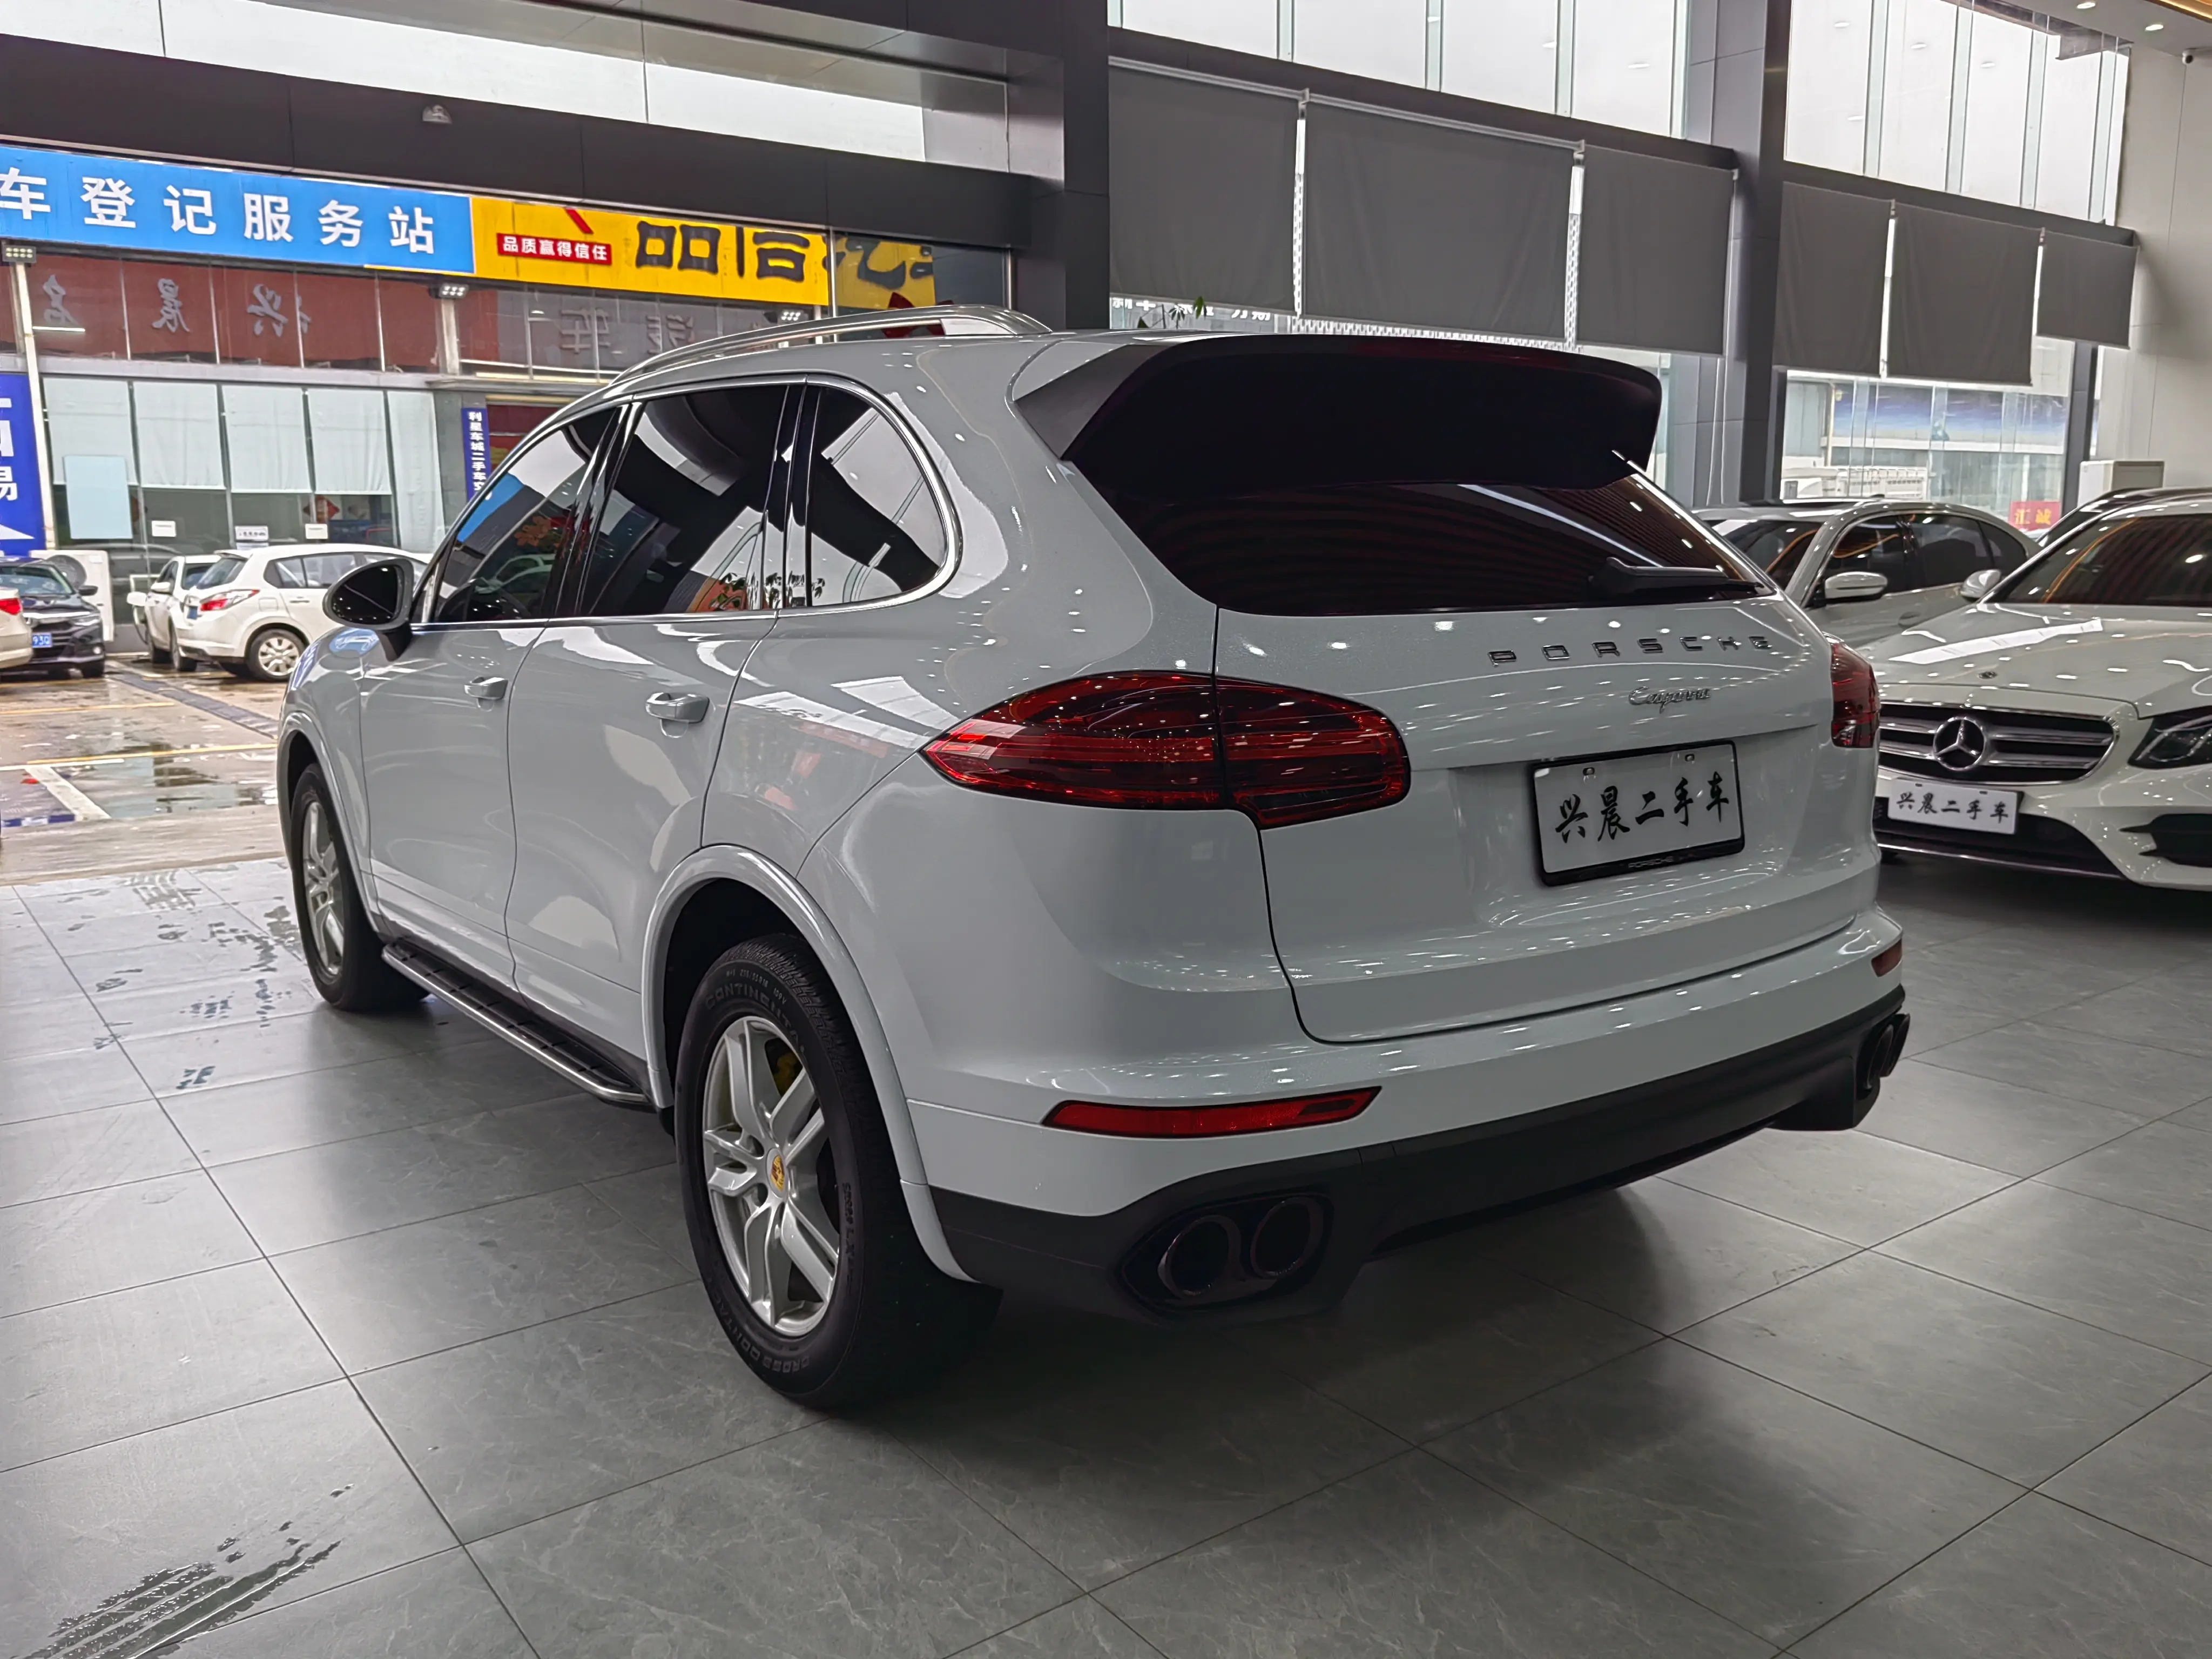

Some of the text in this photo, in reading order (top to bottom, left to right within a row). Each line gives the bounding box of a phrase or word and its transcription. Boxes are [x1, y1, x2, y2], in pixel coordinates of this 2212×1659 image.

[0, 167, 434, 254] 车登记服务站
[502, 235, 608, 261] 品质赢得信任
[1488, 635, 1773, 666] PORSCHE
[1555, 771, 1730, 844] 兴晨二手车
[1896, 791, 2009, 824] 兴晨二手车
